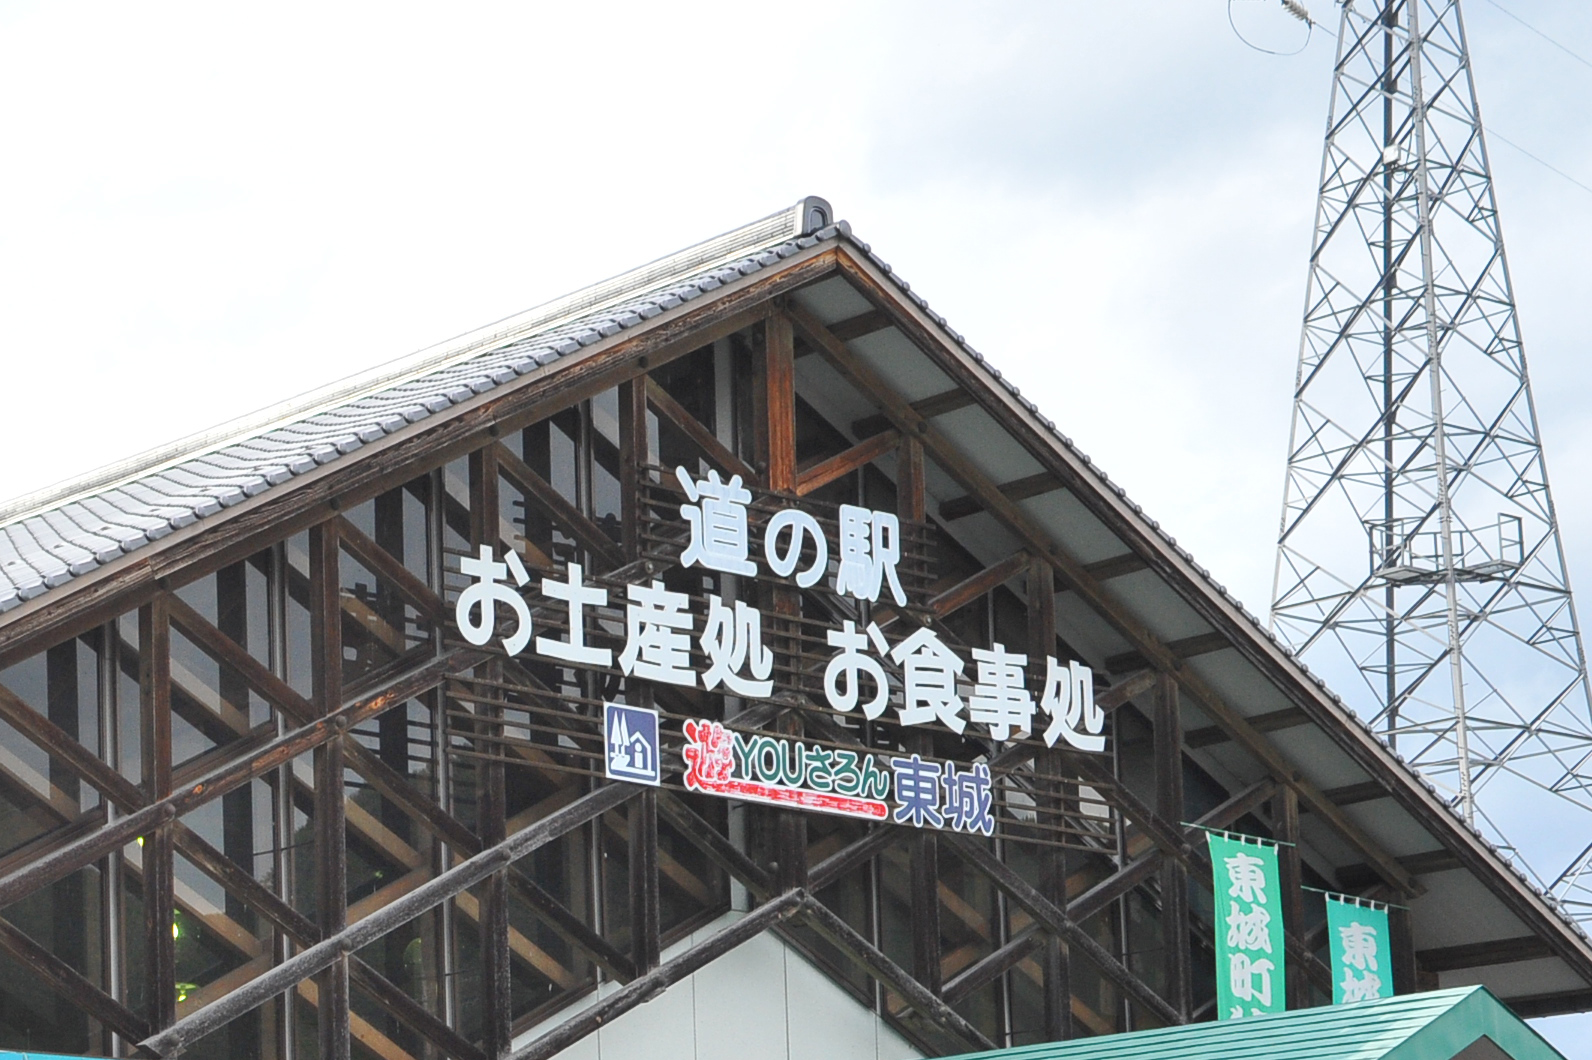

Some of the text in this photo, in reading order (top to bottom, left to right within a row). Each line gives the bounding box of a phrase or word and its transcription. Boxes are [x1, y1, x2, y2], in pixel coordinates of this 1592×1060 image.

[675, 466, 907, 607] 道の駅
[456, 544, 1106, 752] お土産処 お食事処
[1224, 852, 1275, 1019] 東城町
